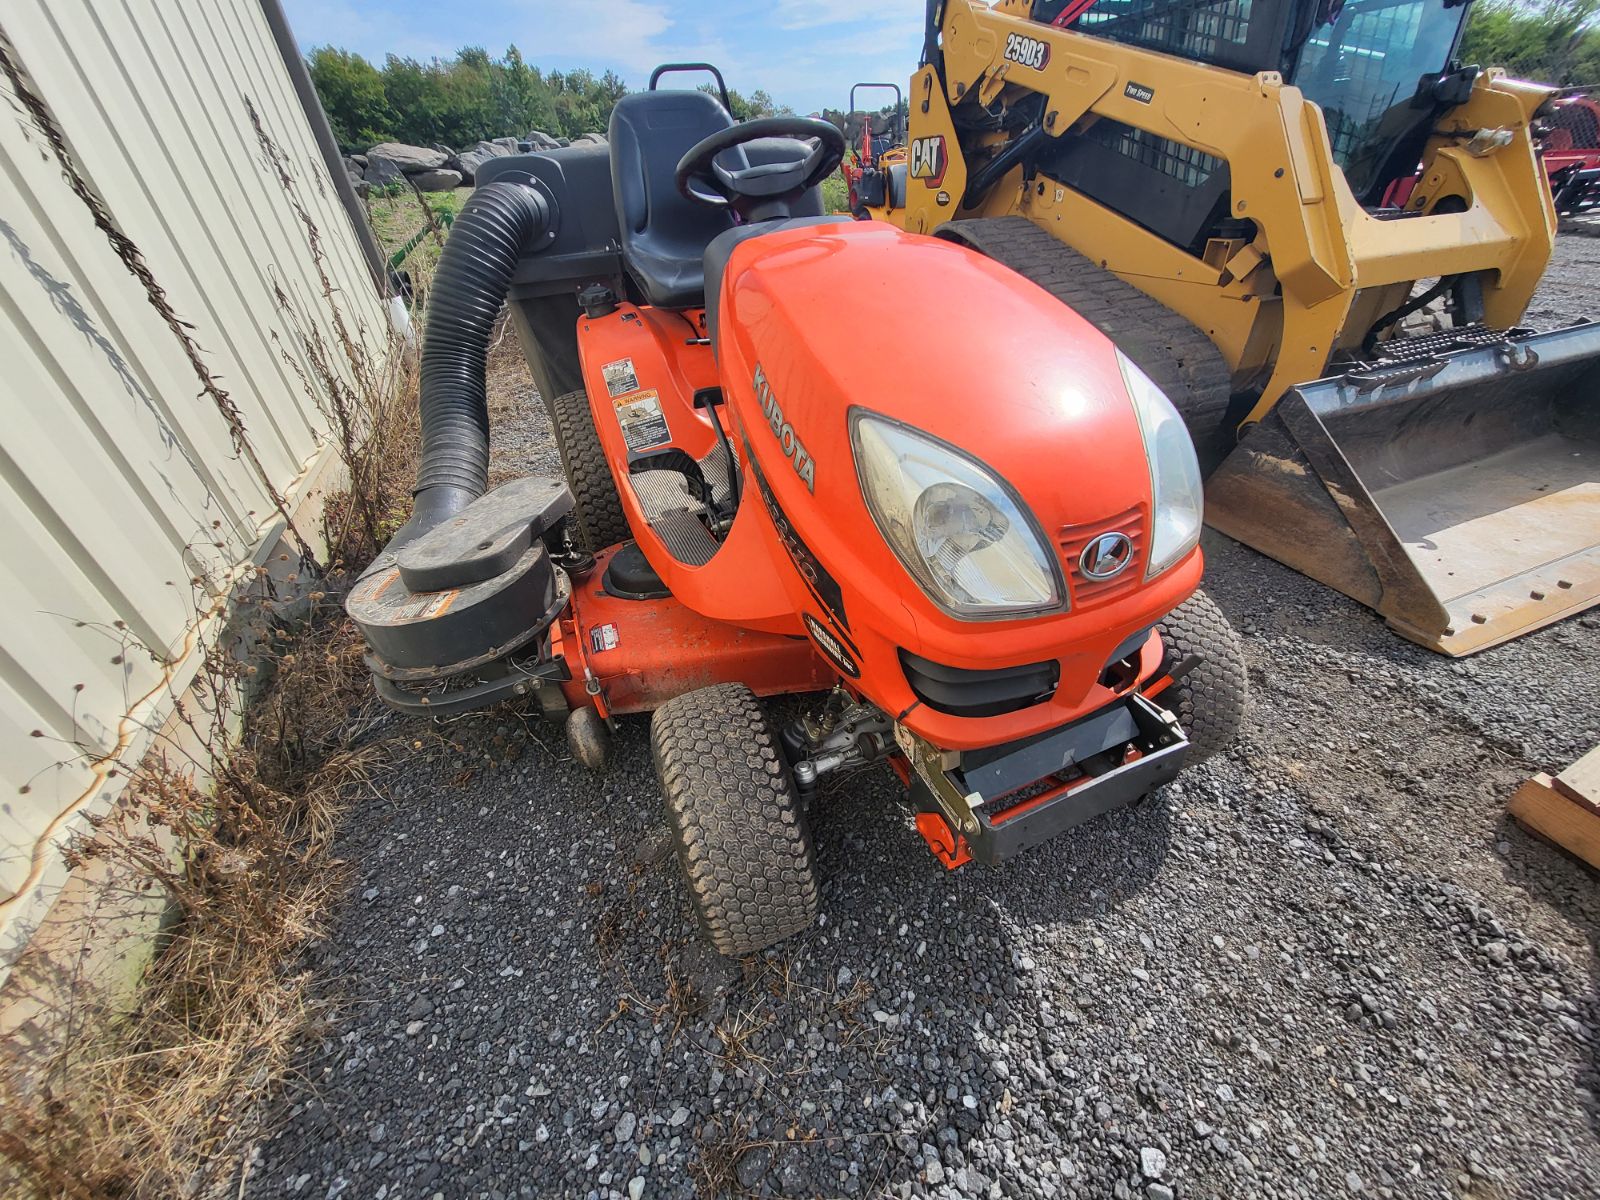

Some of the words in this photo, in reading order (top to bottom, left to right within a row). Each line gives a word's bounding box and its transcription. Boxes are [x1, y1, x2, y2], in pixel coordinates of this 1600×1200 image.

[1004, 32, 1045, 69] 259D3
[911, 137, 940, 178] CAT
[753, 360, 815, 496] KUBOTA
